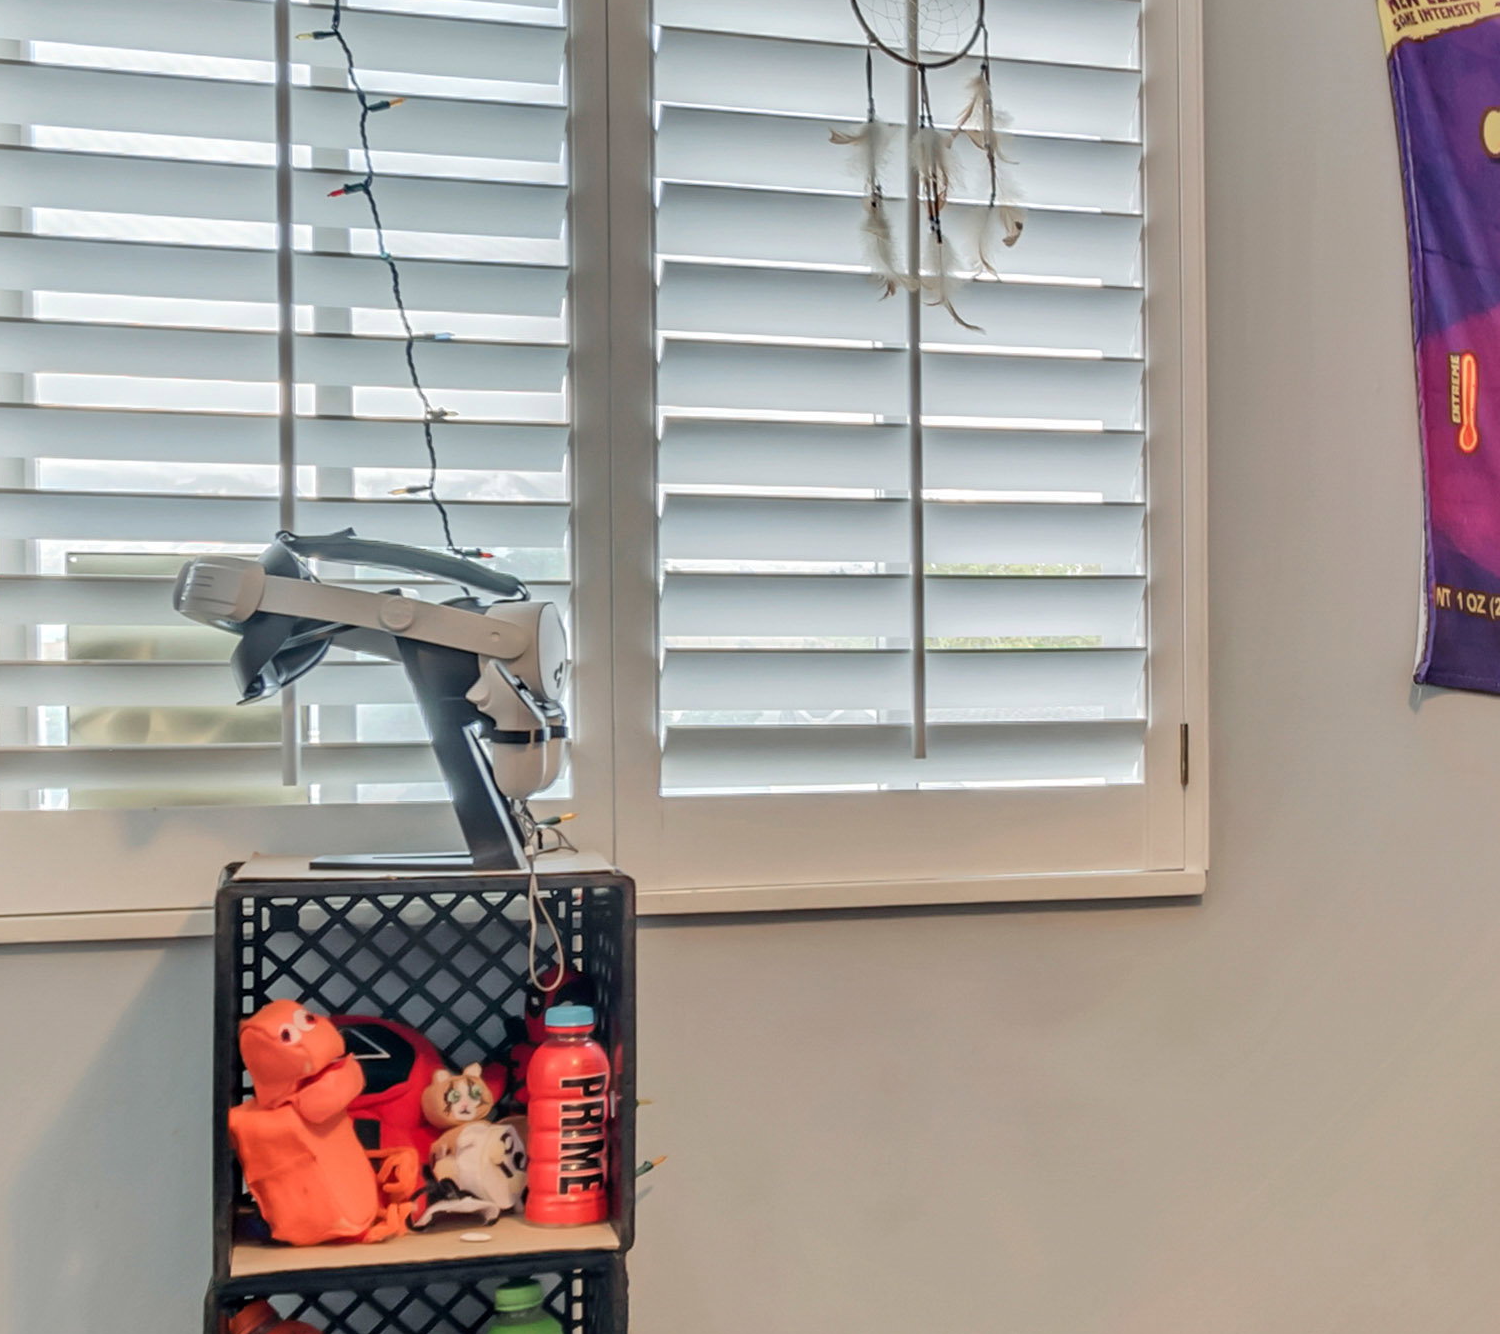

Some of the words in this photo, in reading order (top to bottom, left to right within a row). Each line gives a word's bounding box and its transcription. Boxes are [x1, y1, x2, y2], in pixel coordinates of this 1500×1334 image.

[1417, 1, 1482, 23] INTENSITY
[1456, 591, 1464, 611] 1
[1466, 592, 1487, 615] OZ
[559, 1071, 606, 1196] PRIME
